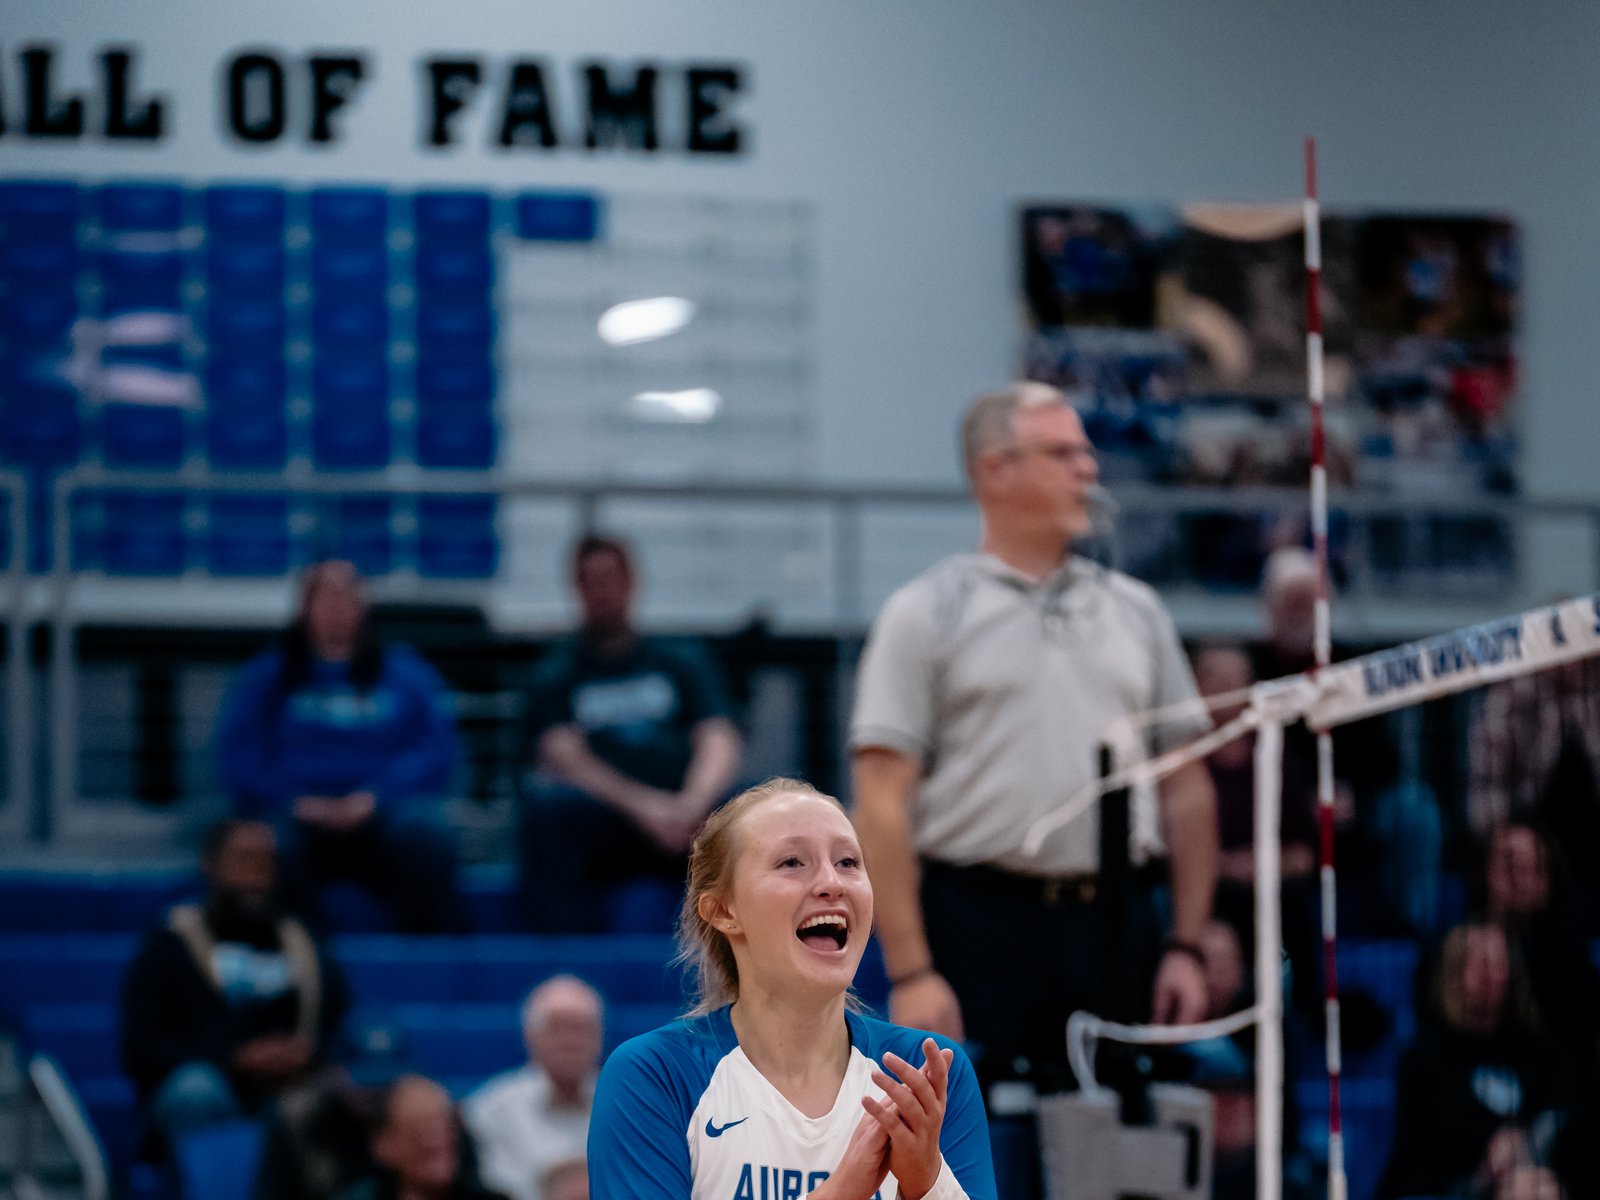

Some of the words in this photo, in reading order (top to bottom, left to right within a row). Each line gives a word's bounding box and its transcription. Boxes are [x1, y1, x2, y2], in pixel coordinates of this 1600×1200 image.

[0, 46, 166, 141] LL
[222, 51, 366, 144] OF
[424, 57, 743, 154] FAME
